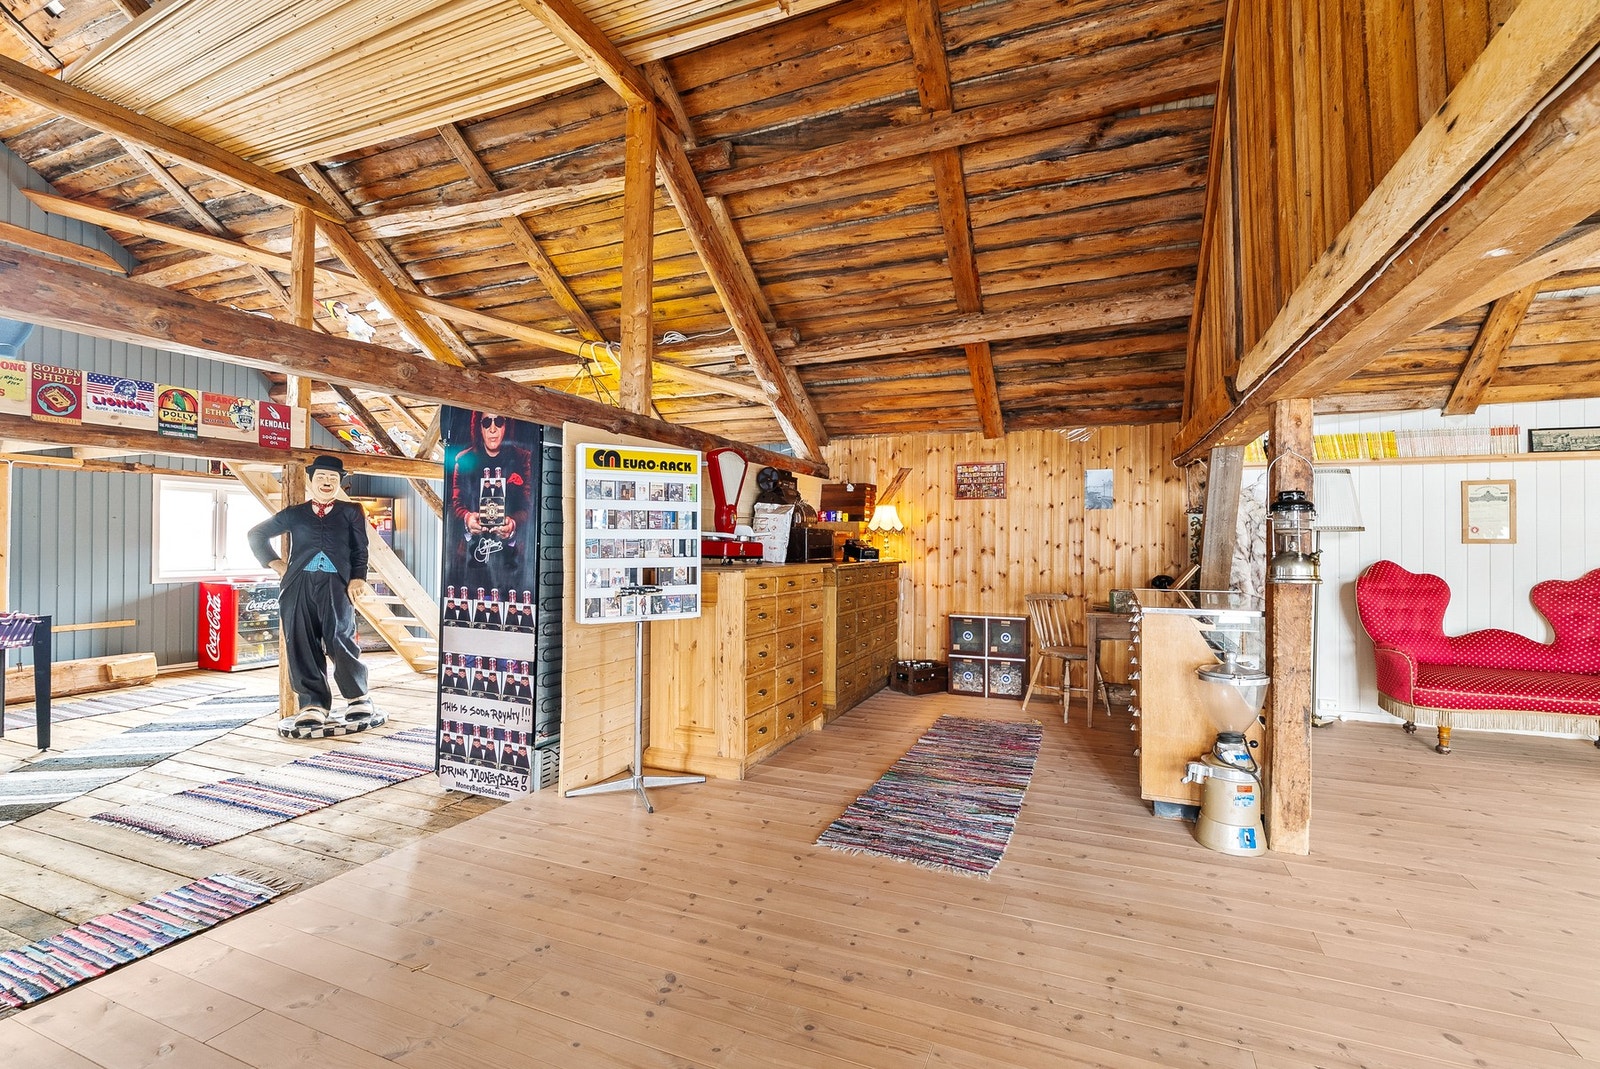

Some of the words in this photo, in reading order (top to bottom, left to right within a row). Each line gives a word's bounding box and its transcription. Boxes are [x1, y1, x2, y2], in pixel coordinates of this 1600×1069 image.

[33, 363, 82, 377] GOLDEN
[33, 371, 81, 386] SHELL
[162, 410, 194, 421] POLLY
[260, 419, 290, 430] KENDALL
[206, 591, 221, 662] Coca-Cola
[441, 702, 458, 712] THIS
[460, 705, 468, 714] IS
[470, 706, 490, 718] SODA
[440, 765, 469, 779] DRINK
[455, 781, 510, 798] MoneyBagSodas.com
